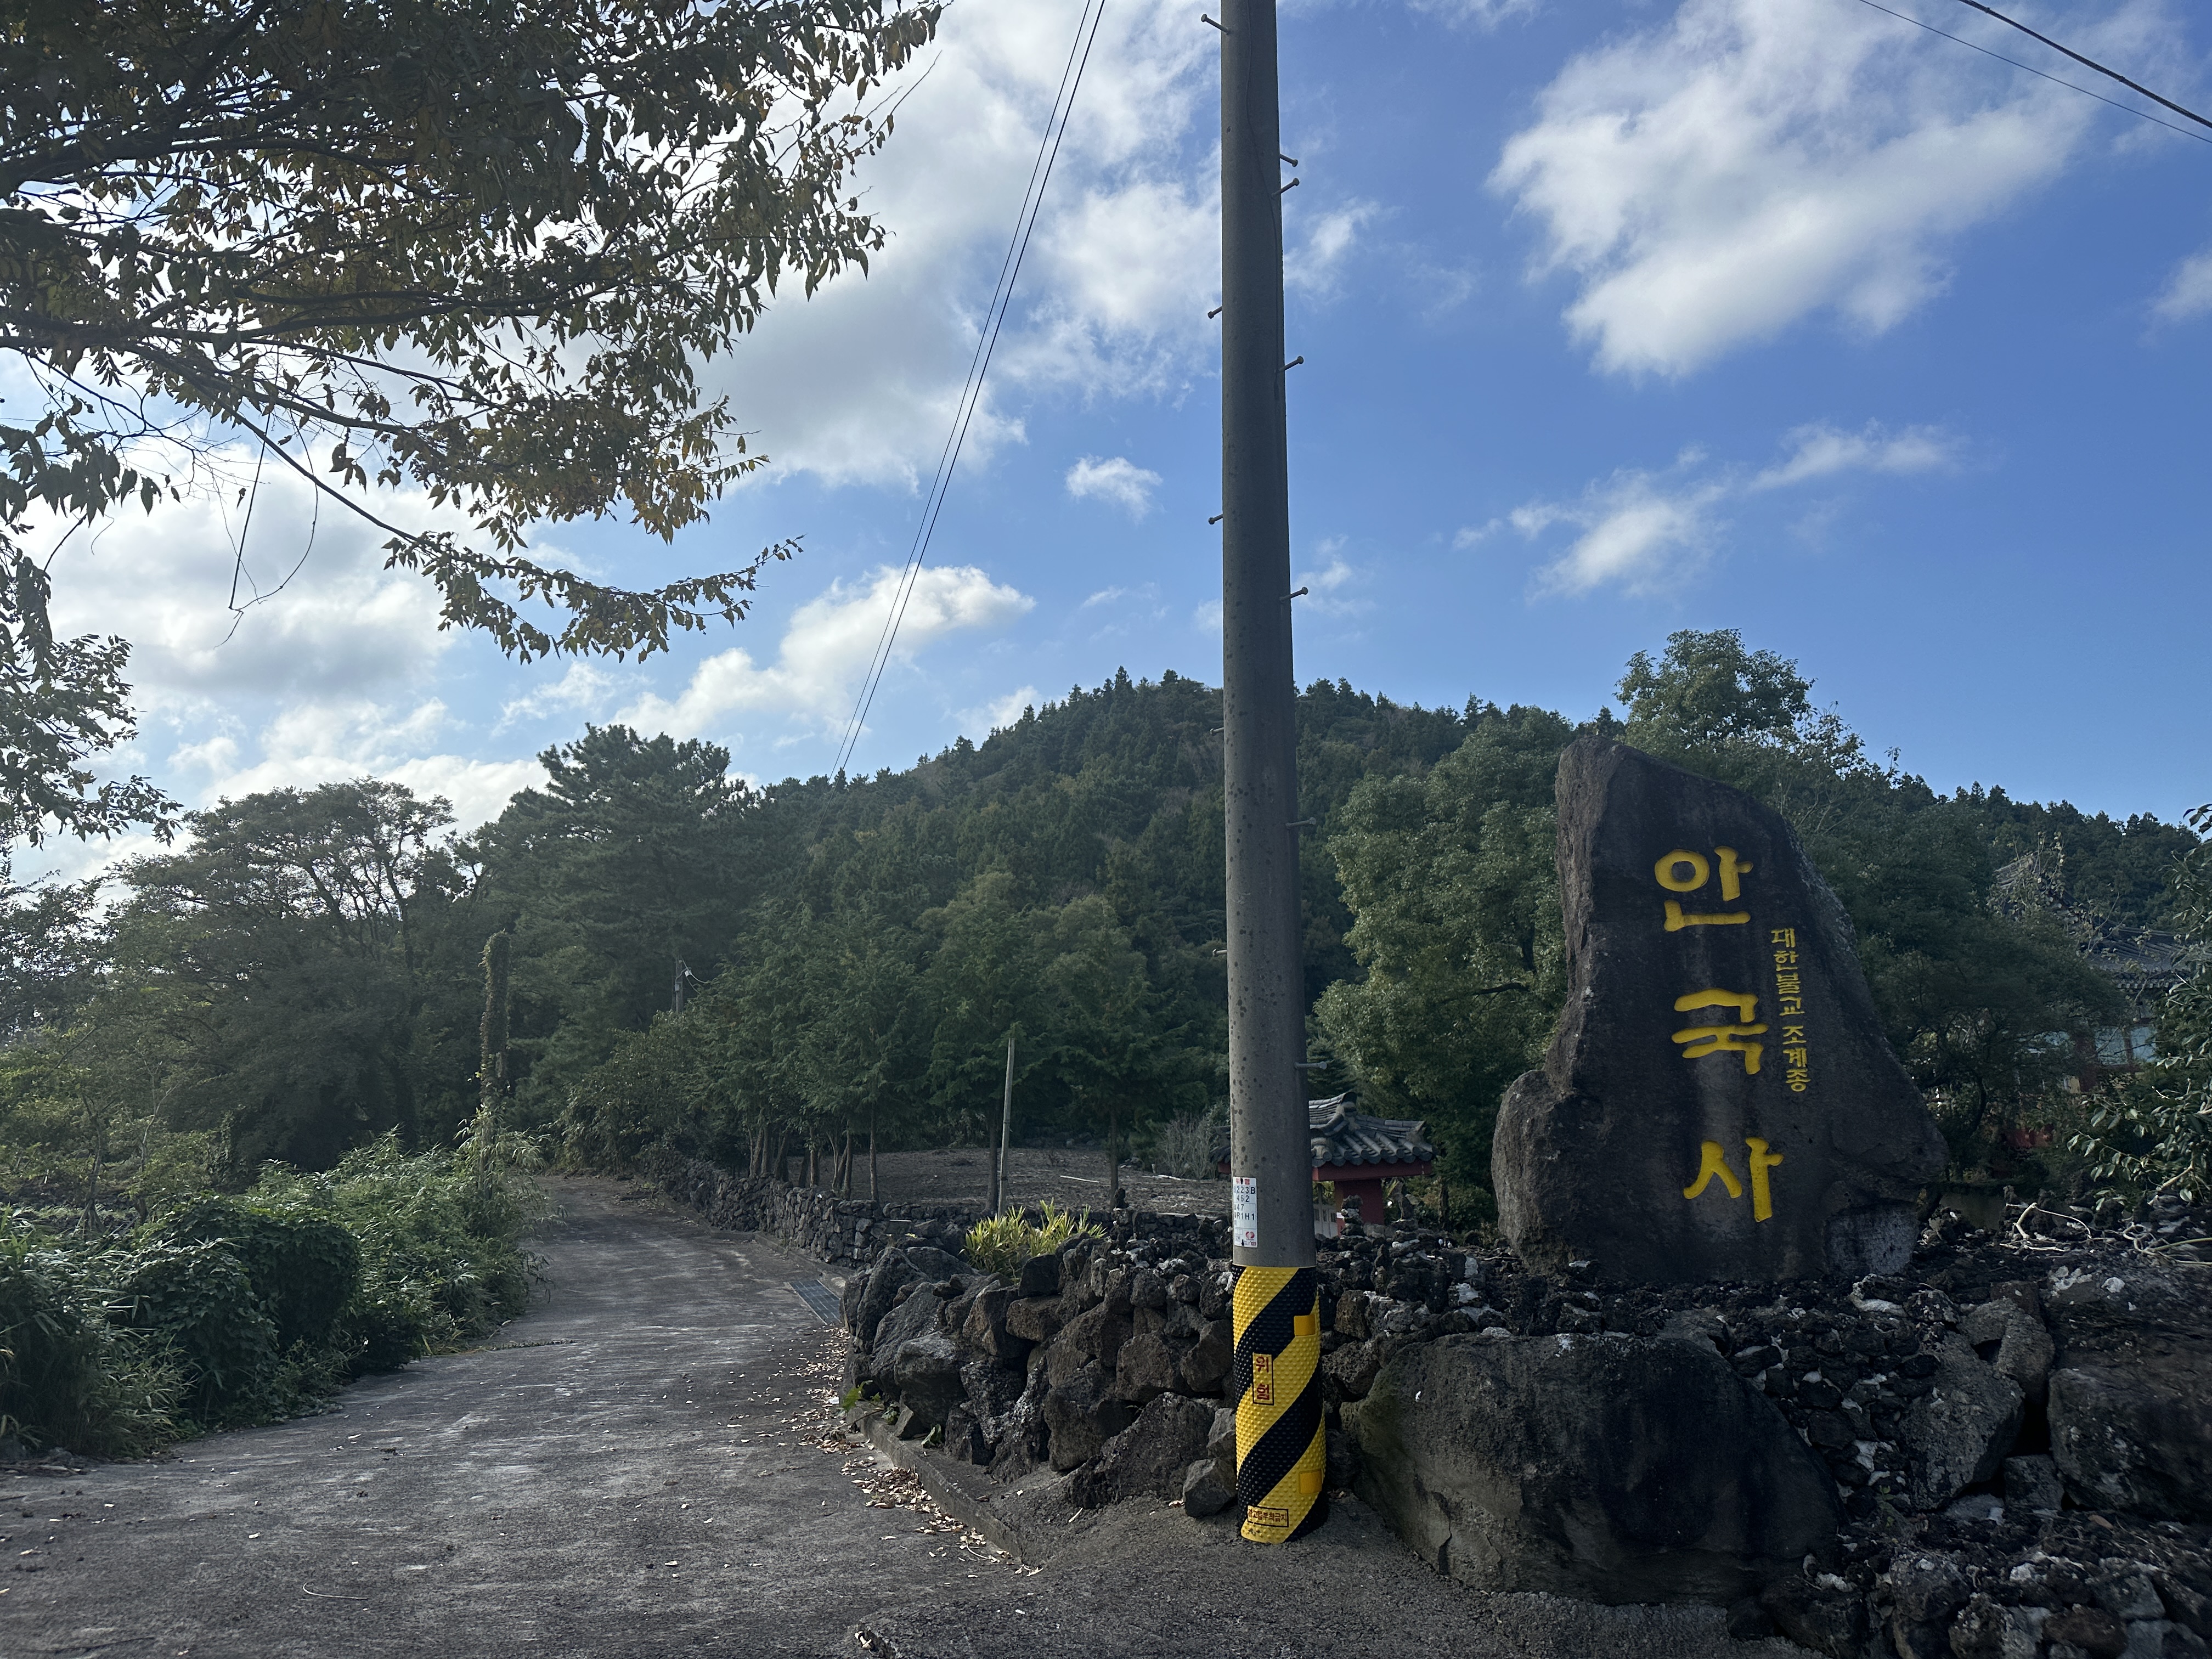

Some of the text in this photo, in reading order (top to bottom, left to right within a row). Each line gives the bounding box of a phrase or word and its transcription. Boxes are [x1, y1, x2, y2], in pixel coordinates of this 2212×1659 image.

[1654, 845, 1784, 1223] 안국사
[1770, 927, 1812, 1092] 대한불교 조계종
[1256, 1356, 1270, 1401] 위험
